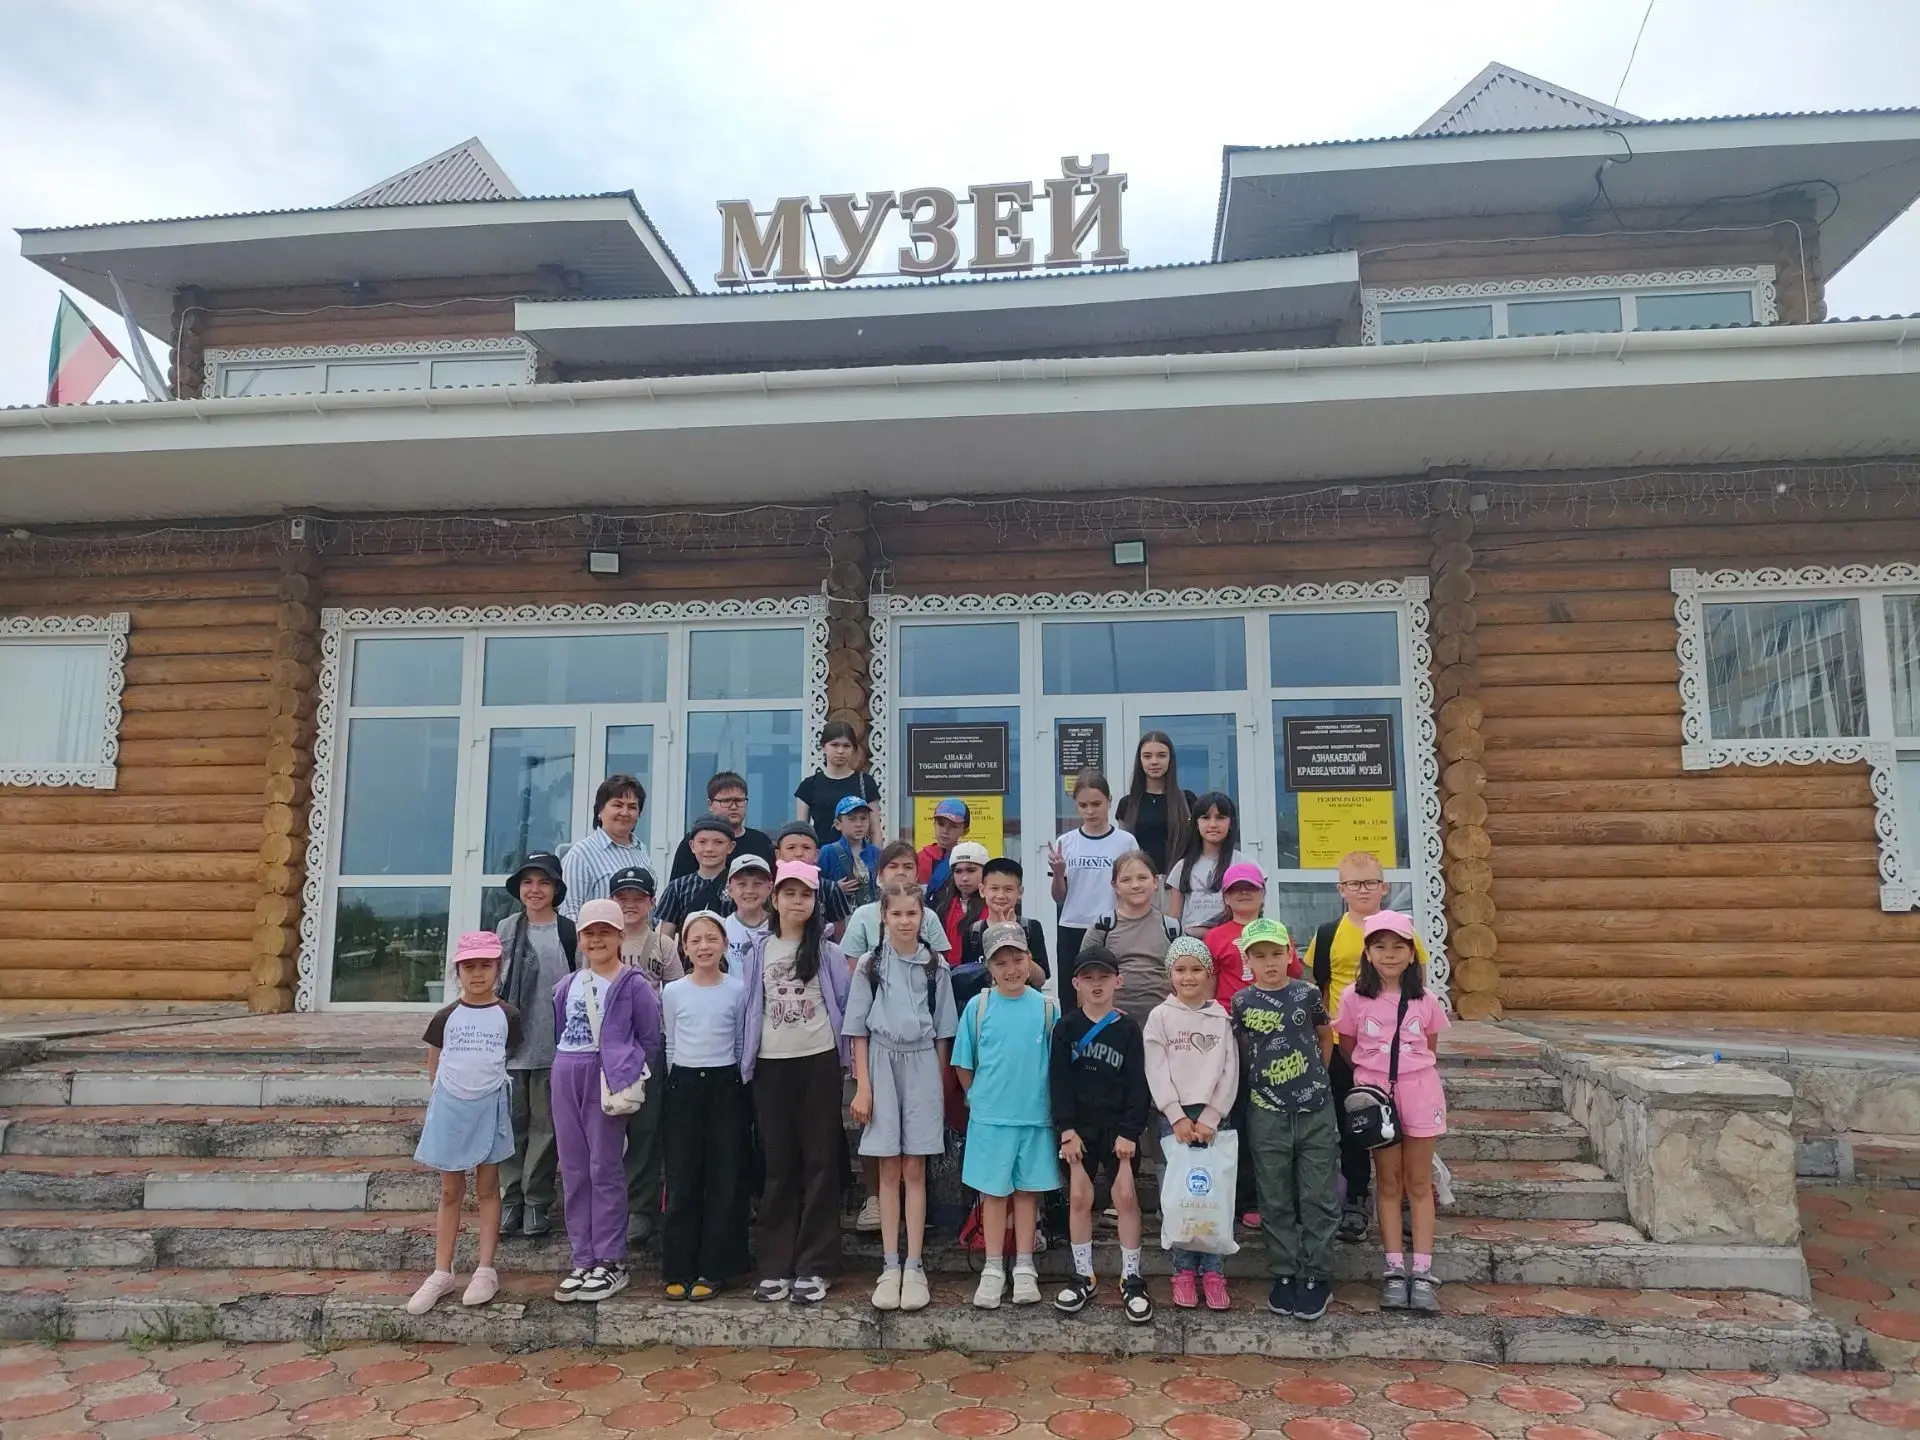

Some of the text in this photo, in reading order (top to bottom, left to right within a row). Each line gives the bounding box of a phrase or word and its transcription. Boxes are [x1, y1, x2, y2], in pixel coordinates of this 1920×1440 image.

[714, 153, 1130, 288] МУЗЕЙ
[943, 752, 973, 761] АЗНАКАЙ
[1311, 751, 1367, 763] АЗНАКАЕВСКИЙ
[1297, 763, 1383, 776] КРАЕВЕДЧЕСКИЙ МУЗЕЙ
